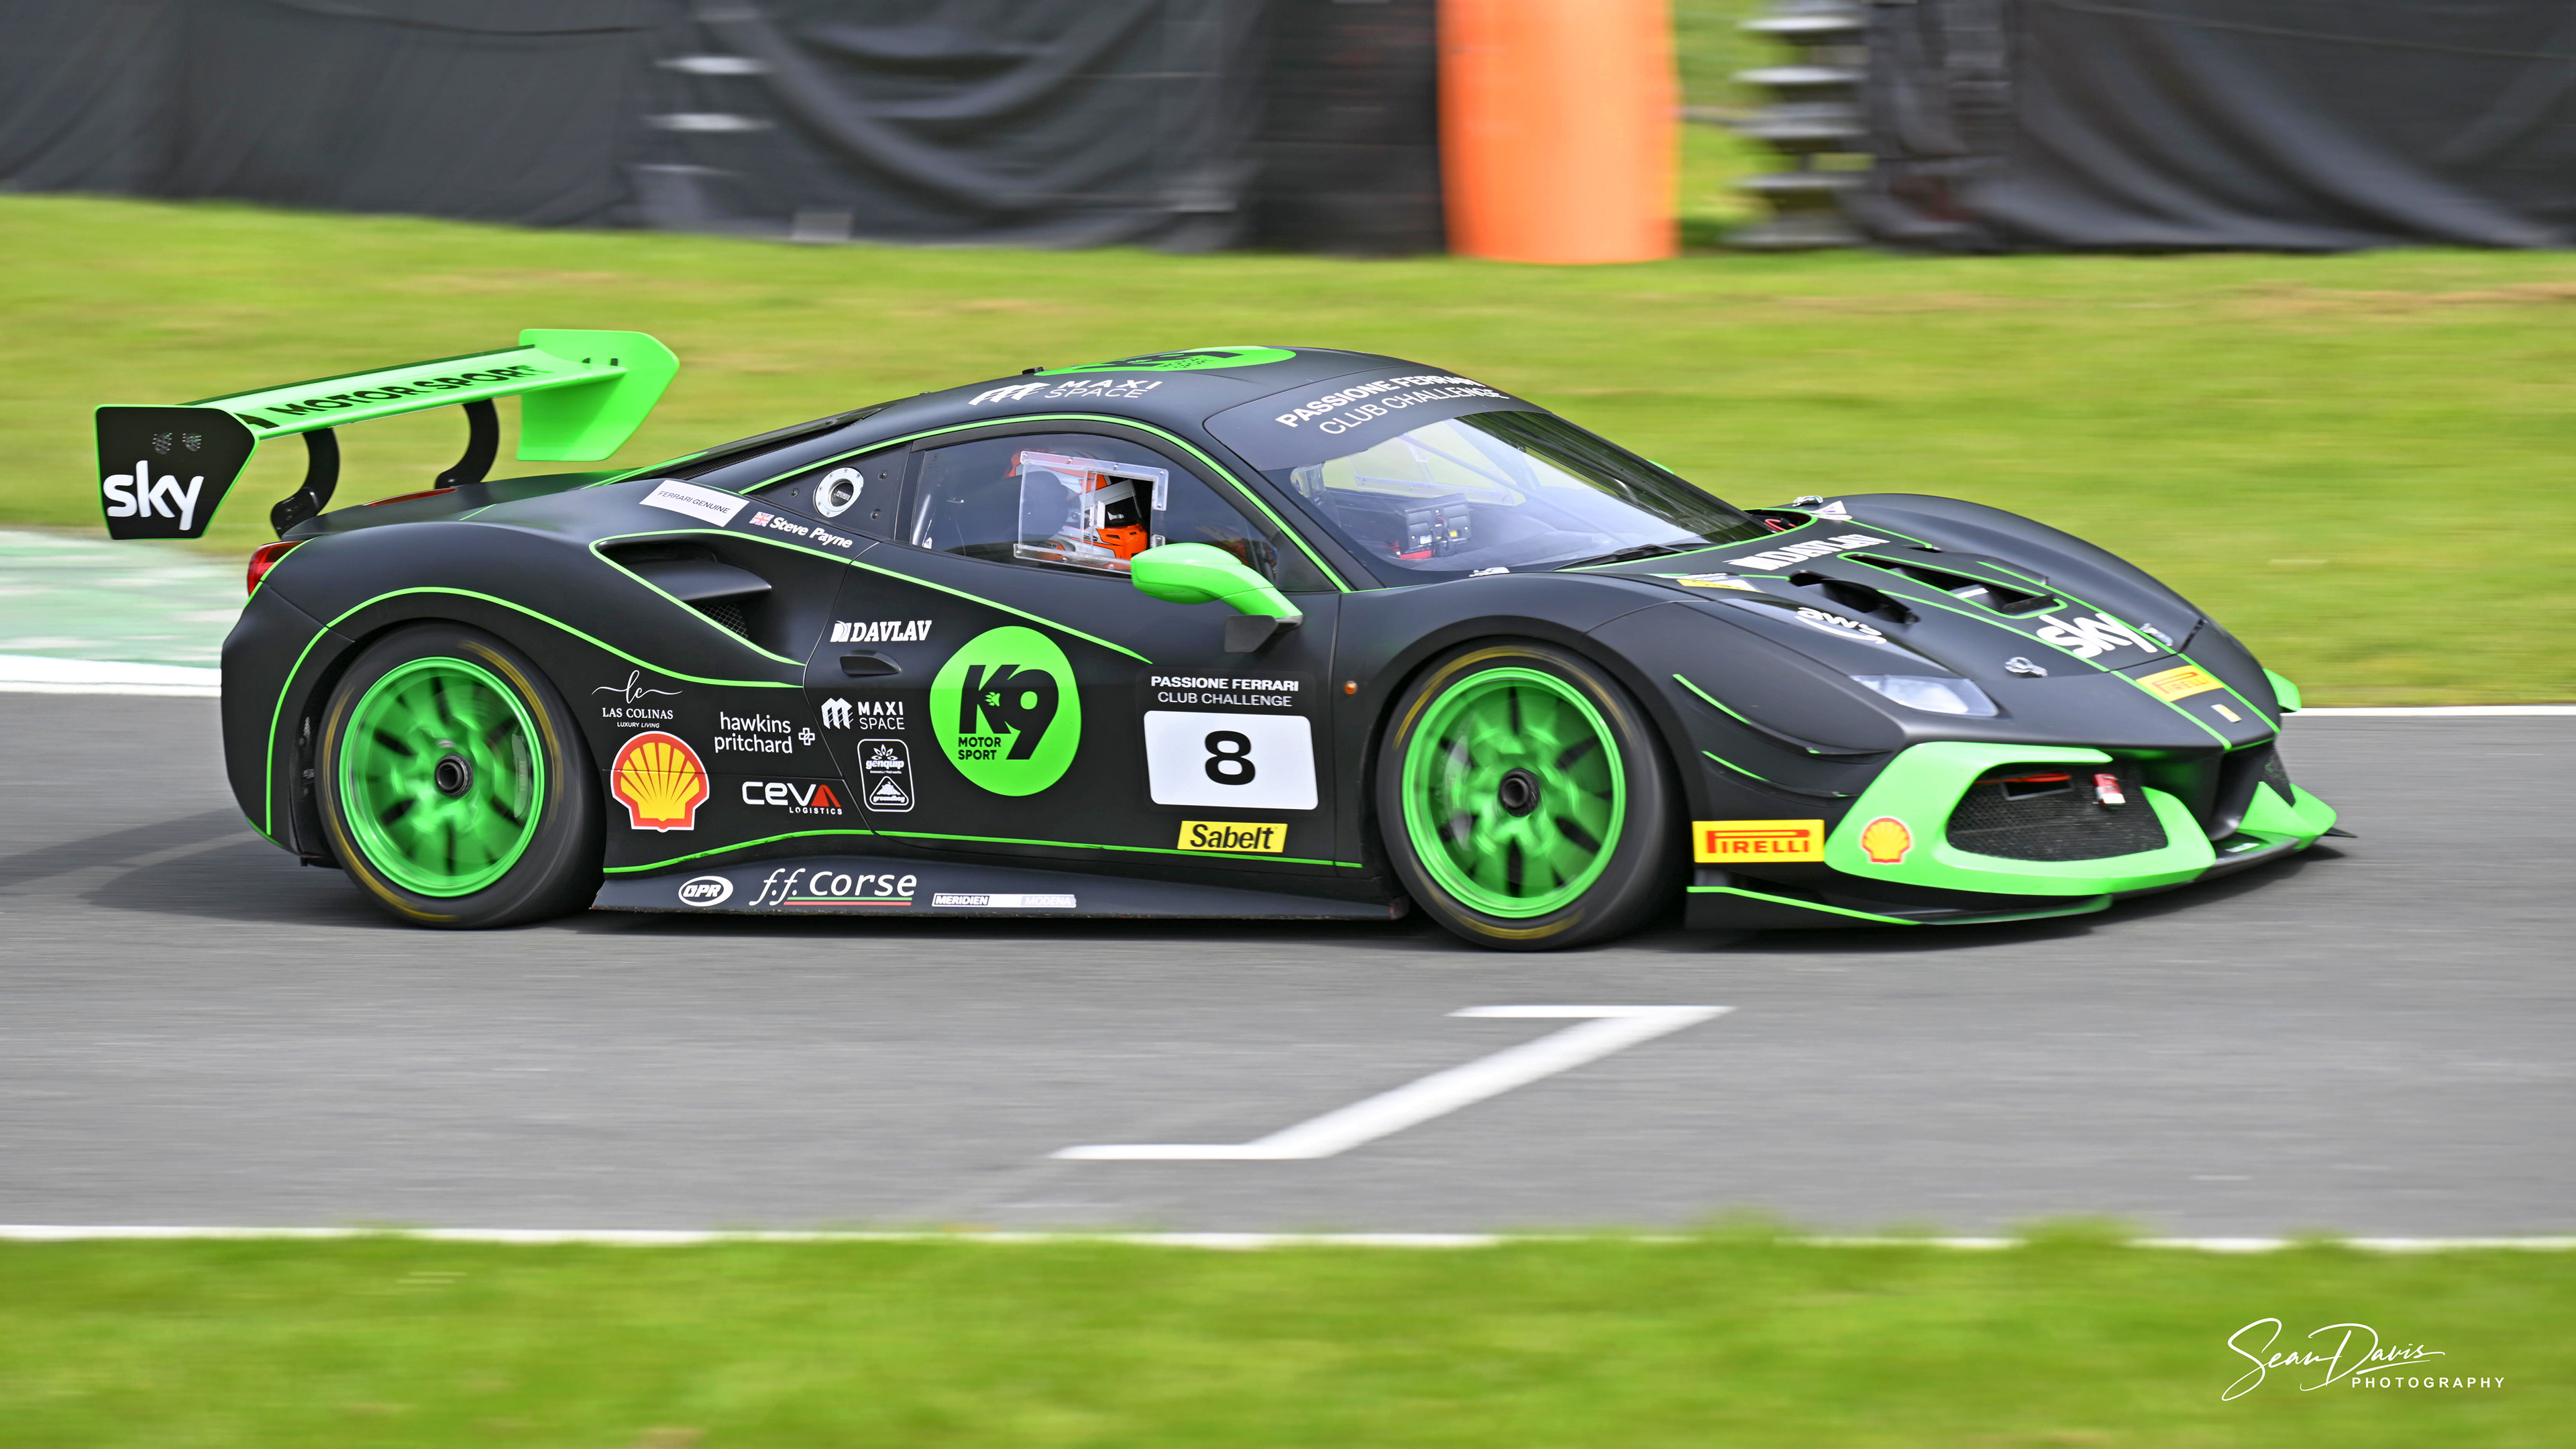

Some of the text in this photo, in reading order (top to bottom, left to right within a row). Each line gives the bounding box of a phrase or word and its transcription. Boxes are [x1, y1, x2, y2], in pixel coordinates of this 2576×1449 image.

[264, 365, 554, 415] MOTOR SPORT
[1044, 387, 1150, 399] SPACE
[1057, 379, 1163, 389] MAXI
[1275, 380, 1401, 428] PASSIONE
[1319, 387, 1510, 435] CLUB CHALLENGE
[103, 460, 204, 531] sky
[657, 490, 731, 515] FERRARI GENUINE
[769, 517, 853, 549] Steve Payne
[849, 620, 932, 642] DAVLAV
[1796, 607, 1882, 636] aws
[1150, 676, 1299, 692] PASSIONE FERRARI
[857, 701, 904, 715] MAXI
[1157, 692, 1293, 707] CLUB CHALLENGE
[602, 708, 674, 720] LAS COLINAS
[720, 711, 792, 734] hawkins
[959, 664, 1059, 760] K9
[859, 717, 906, 730] SPACE
[714, 733, 793, 754] pritchard
[958, 737, 1002, 747] MOTOR
[865, 760, 905, 769] genquip
[958, 749, 997, 760] SPORT
[1204, 730, 1256, 786] 8
[873, 795, 906, 803] groundhog
[789, 807, 843, 815] LOGISTICS
[1189, 824, 1275, 850] Sabelt
[1706, 829, 1810, 854] PIRELLI
[808, 871, 917, 897] Corse
[935, 896, 1071, 906] MERIDIEN MODENA
